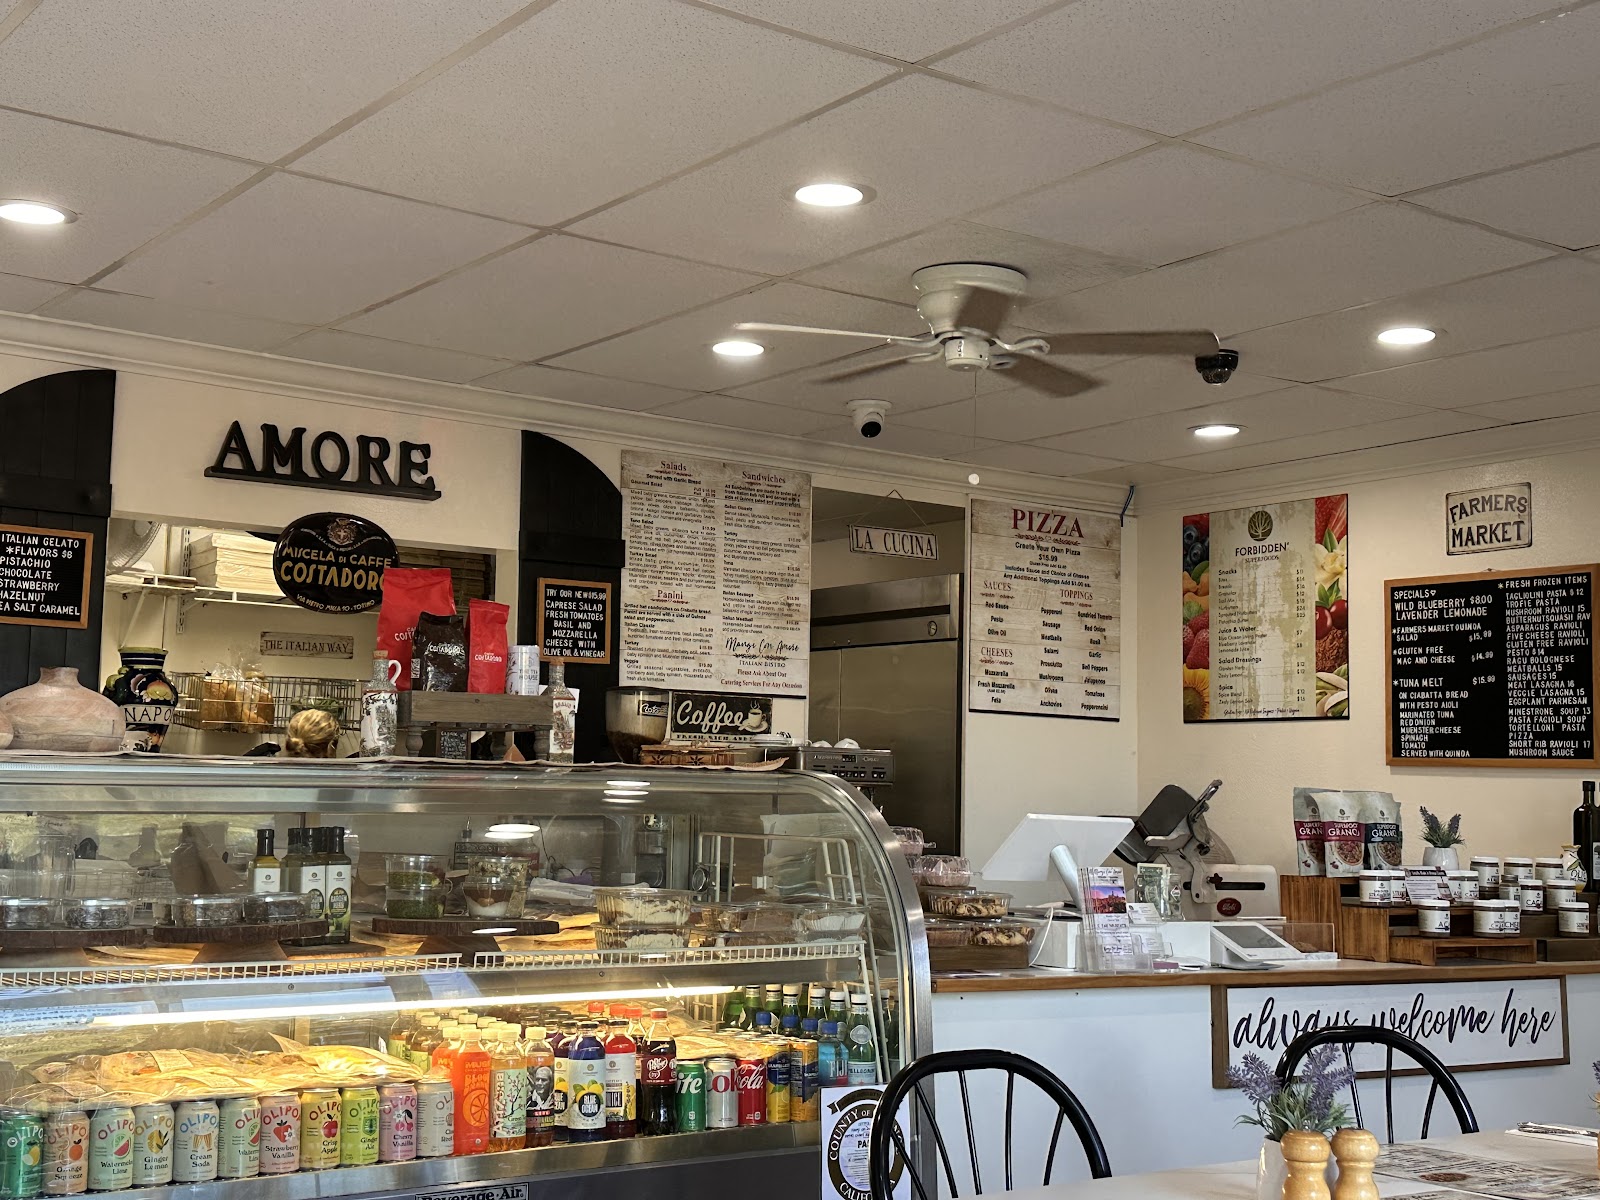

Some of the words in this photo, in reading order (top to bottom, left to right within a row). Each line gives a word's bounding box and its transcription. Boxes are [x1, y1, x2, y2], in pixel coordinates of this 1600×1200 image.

[211, 420, 436, 492] AMORE
[661, 461, 686, 471] Salads
[742, 471, 786, 484] Sandwiches
[1450, 495, 1527, 523] FARMERS
[1012, 508, 1084, 538] PIZZA
[1452, 521, 1525, 548] MARKET
[2, 534, 38, 545] ITALIAN
[43, 538, 79, 548] GELATO
[855, 529, 873, 550] LA
[884, 532, 934, 556] CUCINA
[282, 547, 335, 562] MISCELA
[1015, 542, 1035, 550] Create
[1036, 544, 1049, 552] Your
[1066, 548, 1080, 556] Pizza
[1235, 543, 1286, 557] FORBIDDEN
[0, 556, 50, 568] PISTACHIO
[0, 568, 52, 579] CHOCOLATE
[0, 579, 60, 591] STRAWBERRY
[984, 580, 1012, 591] SAUCES
[1506, 580, 1530, 588] FRESH
[1534, 578, 1561, 586] FROZEN
[1565, 576, 1587, 584] ITEMS
[658, 590, 683, 600] Panini
[1060, 589, 1093, 600] TOPPINGS
[1394, 589, 1429, 600] SPECIALS
[1506, 591, 1543, 600] TAGLIOLINI
[14, 602, 36, 612] SALT
[40, 604, 80, 615] CARAMEL
[546, 600, 576, 610] CAPRESE
[579, 602, 602, 611] SALAD
[1395, 602, 1414, 611] WILD
[1418, 598, 1465, 610] BLUEBERRY
[546, 610, 568, 619] FRESH
[570, 611, 603, 620] TOMATOES
[1396, 610, 1438, 620] LAVENDER
[1444, 607, 1487, 618] LEMONADE
[554, 620, 573, 628] BASIL
[1506, 623, 1549, 632] ASPARAGUS
[1554, 622, 1582, 630] RAVIOLI
[553, 630, 597, 639] MOZZARELLA
[264, 640, 282, 649] THE
[286, 641, 324, 652] ITALIAN
[327, 642, 349, 653] WAY
[546, 639, 572, 647] CHEESE
[981, 646, 1013, 658] CHEESES
[1530, 655, 1575, 664] BOLOGNESE
[1507, 664, 1551, 672] MEATBALLS
[677, 700, 743, 733] Coffee
[1370, 993, 1496, 1043] welcome
[1500, 988, 1556, 1048] here
[583, 1095, 596, 1104] BLUE
[582, 1104, 598, 1113] OCEAN
[830, 1109, 858, 1160] COUNTY
